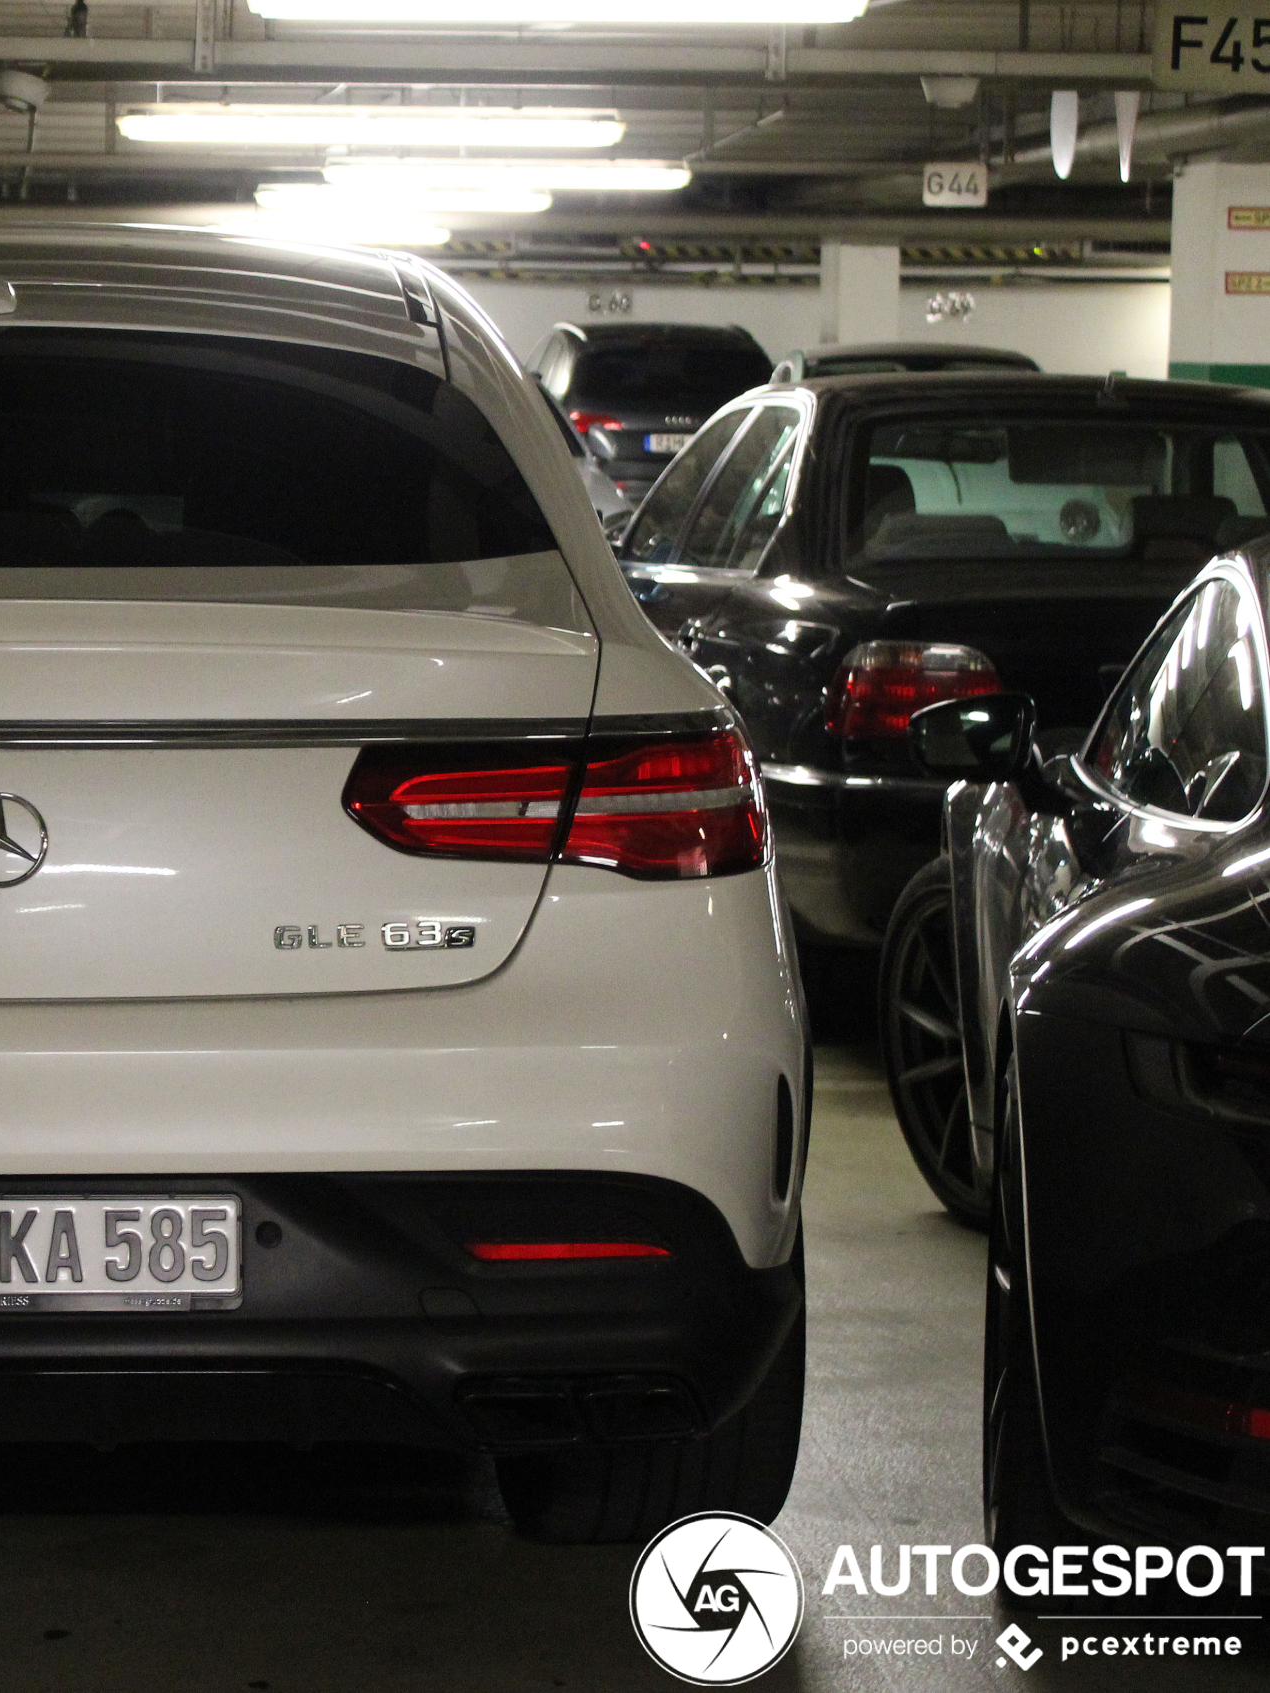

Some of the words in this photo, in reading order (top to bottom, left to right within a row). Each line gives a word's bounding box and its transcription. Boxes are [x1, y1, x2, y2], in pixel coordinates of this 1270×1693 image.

[273, 924, 365, 950] GLE
[0, 1210, 83, 1283] KA
[105, 1209, 229, 1282] 585
